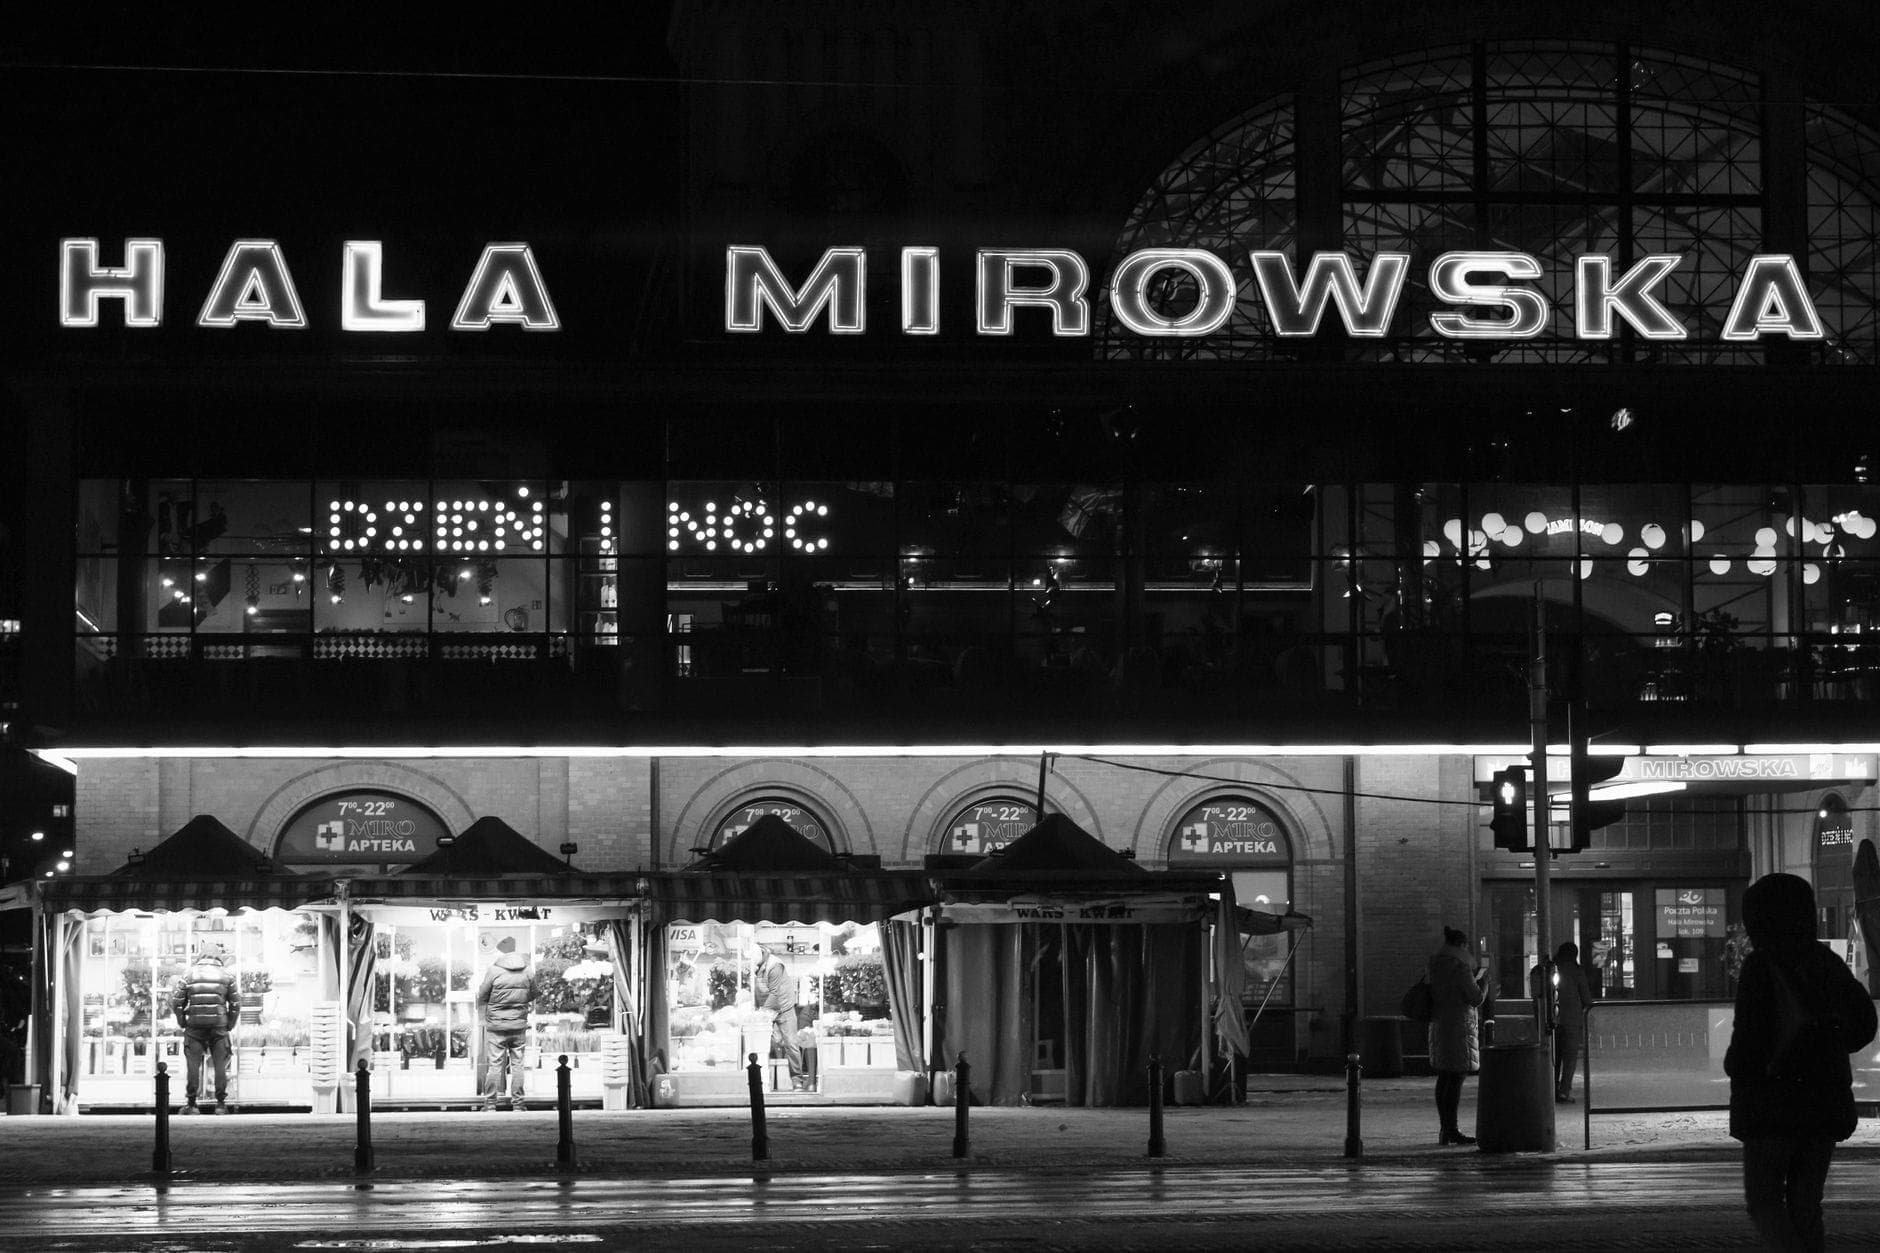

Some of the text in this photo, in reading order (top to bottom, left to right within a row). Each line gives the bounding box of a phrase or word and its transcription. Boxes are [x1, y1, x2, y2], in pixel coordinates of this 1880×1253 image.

[60, 237, 1825, 341] HALA MIROWSKA
[602, 501, 613, 550] I
[669, 500, 828, 553] NOC
[1641, 759, 1797, 778] MIROWSKA
[347, 819, 416, 839] MIRO
[982, 821, 1035, 841] MIR
[1211, 821, 1276, 840] MIRO
[348, 840, 416, 852] APTEKA
[1212, 842, 1277, 853] APTEKA
